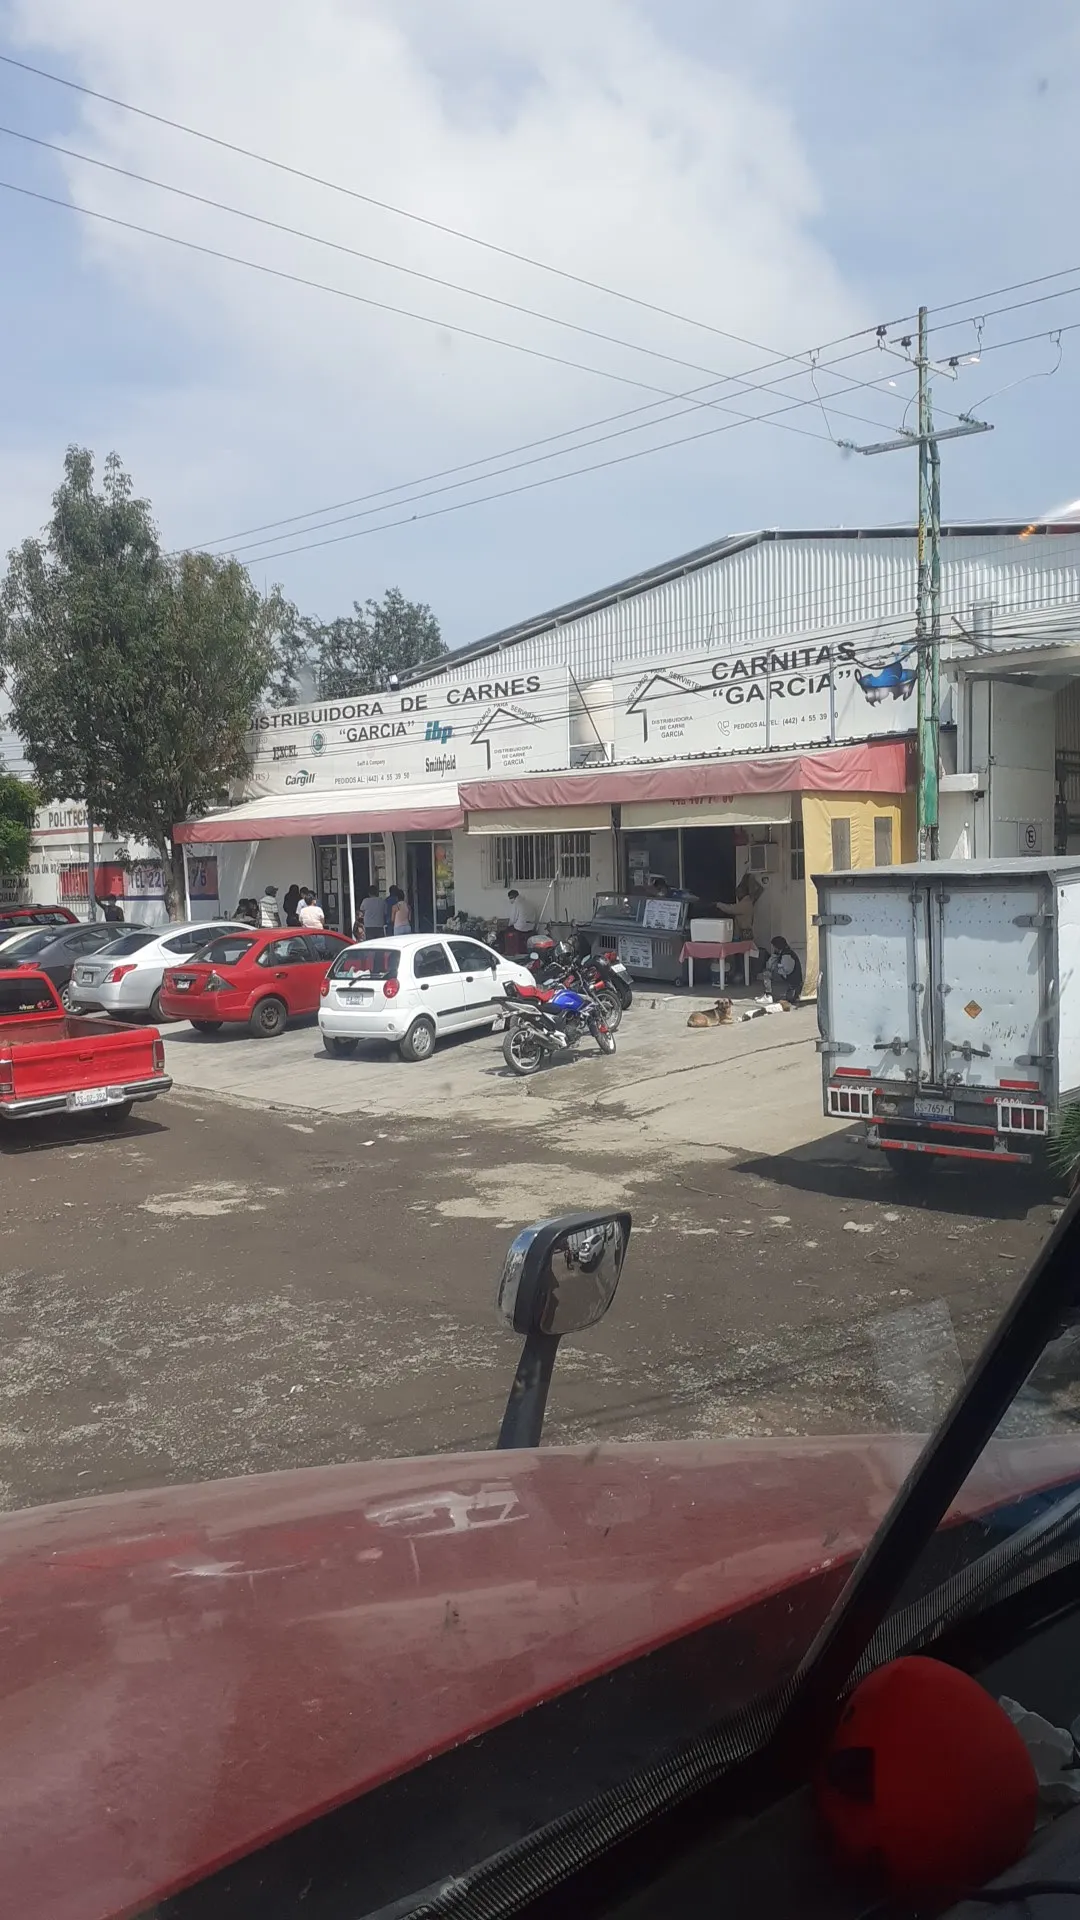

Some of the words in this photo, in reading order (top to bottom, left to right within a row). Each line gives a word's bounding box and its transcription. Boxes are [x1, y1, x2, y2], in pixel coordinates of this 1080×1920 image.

[711, 642, 856, 681] CARNITAS
[249, 702, 384, 731] DISTRIBUIDORA
[400, 695, 428, 712] DE
[447, 675, 541, 704] CARNES
[652, 716, 694, 725] DISTRIBUIDORA
[733, 720, 758, 730] PEDIDOS
[782, 715, 798, 725] (442)
[800, 714, 806, 722] 4
[808, 713, 817, 722] 55
[819, 712, 828, 721] 39
[425, 720, 454, 745] ibp
[661, 730, 684, 738] GARCIA
[494, 745, 533, 754] DISTRIBUIDORA
[425, 753, 457, 778] Smithfield
[503, 759, 525, 767] GARCIA
[285, 770, 318, 787] Cargill
[334, 776, 356, 784] PEDIDOS
